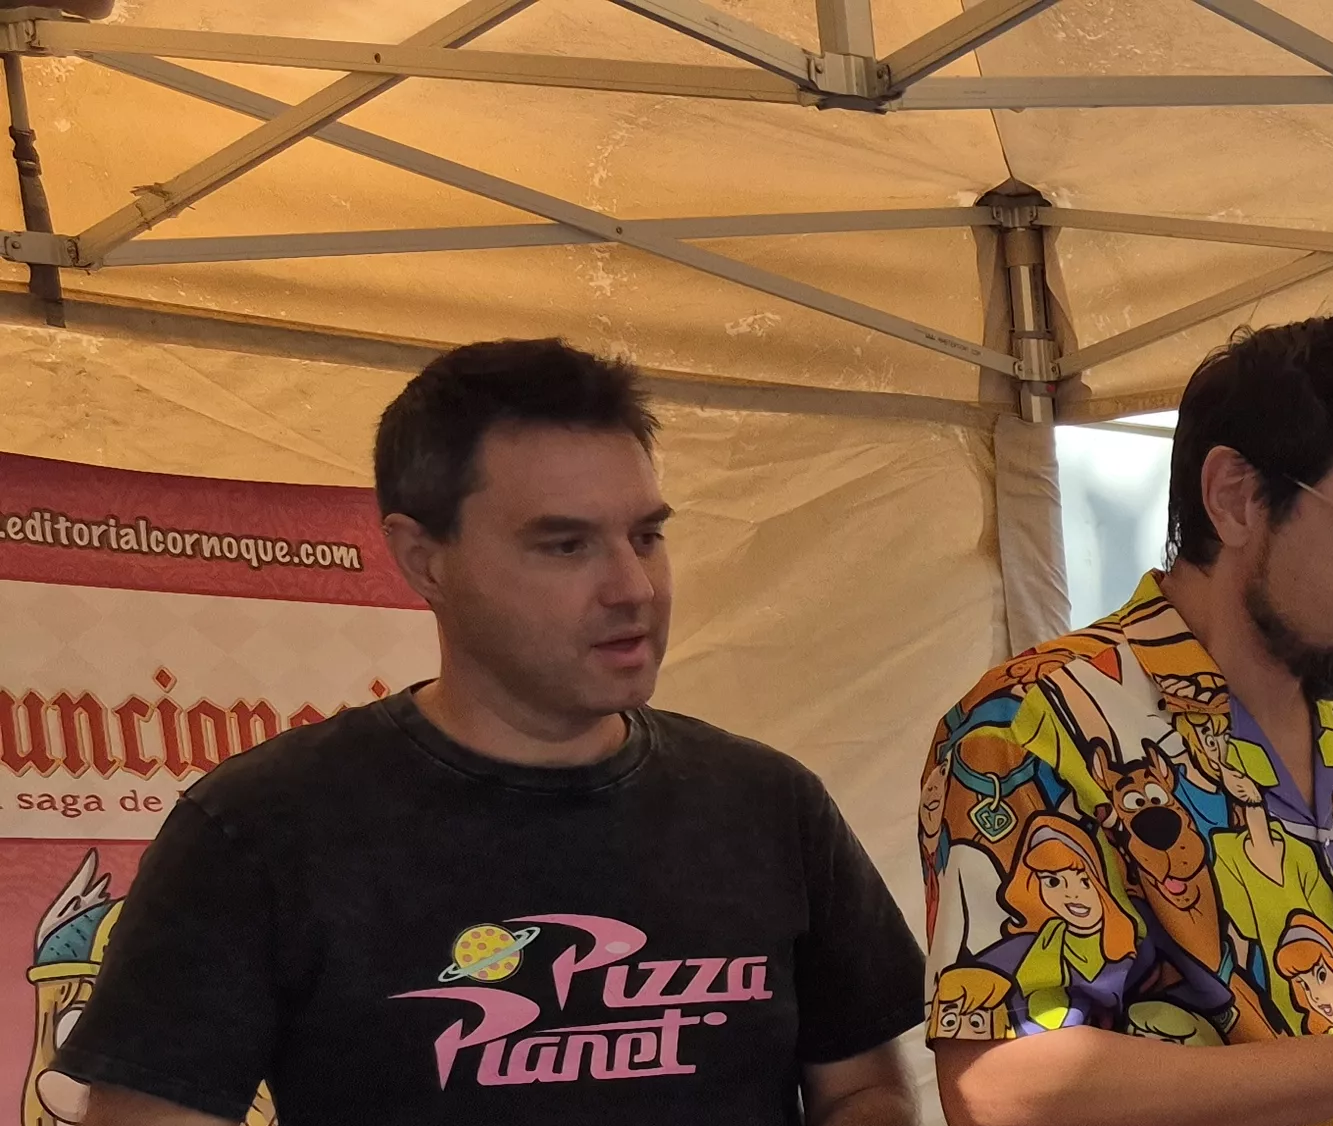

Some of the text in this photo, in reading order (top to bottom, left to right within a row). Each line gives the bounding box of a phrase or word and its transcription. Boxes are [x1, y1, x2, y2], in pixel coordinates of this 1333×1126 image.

[17, 790, 163, 819] saga de
[503, 913, 773, 1010] Pizza
[388, 986, 728, 1091] Planet
